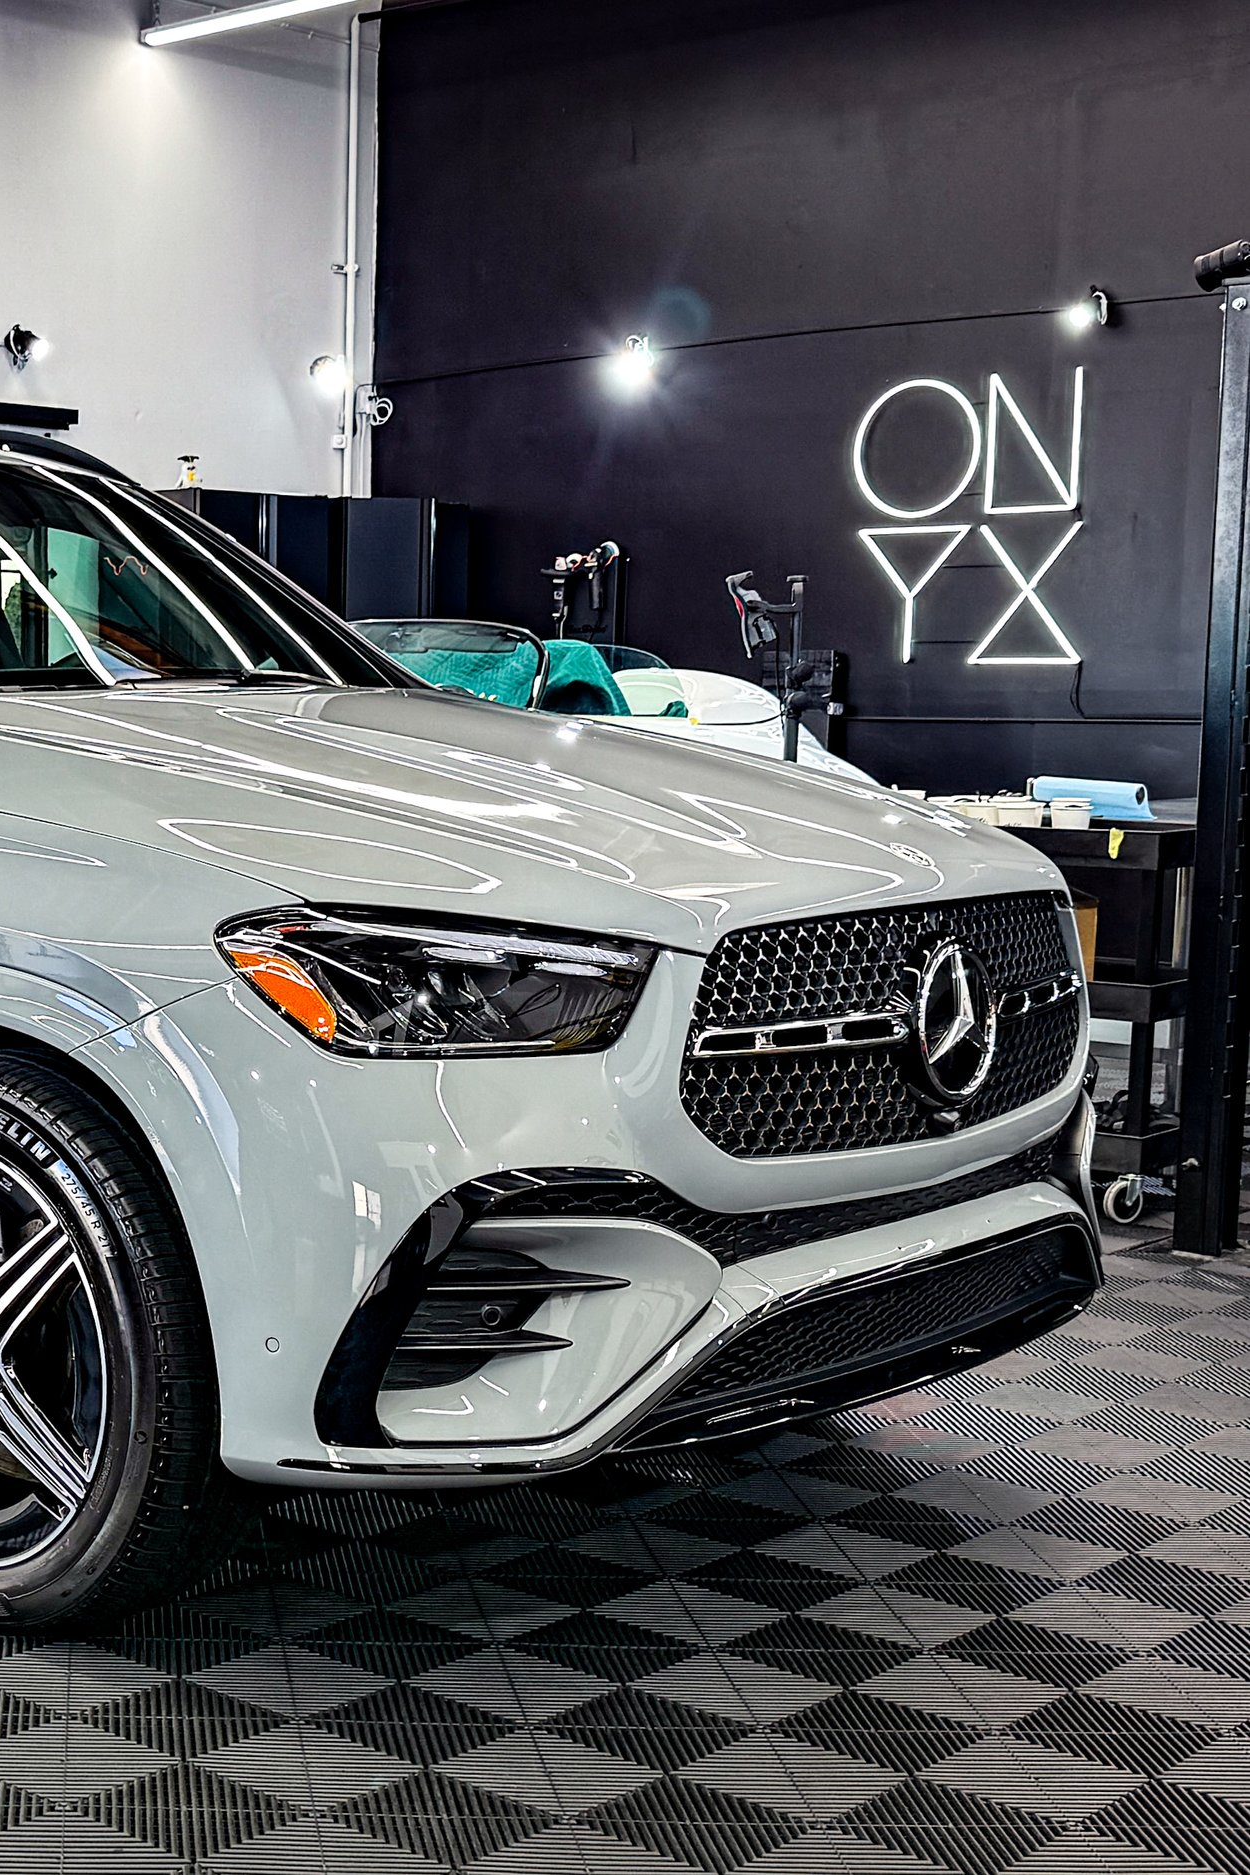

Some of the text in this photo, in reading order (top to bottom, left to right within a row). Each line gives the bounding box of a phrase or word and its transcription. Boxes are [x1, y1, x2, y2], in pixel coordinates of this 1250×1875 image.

[853, 365, 1084, 518] ON
[858, 521, 1084, 665] YX
[61, 1173, 111, 1248] 275/45 R 21
